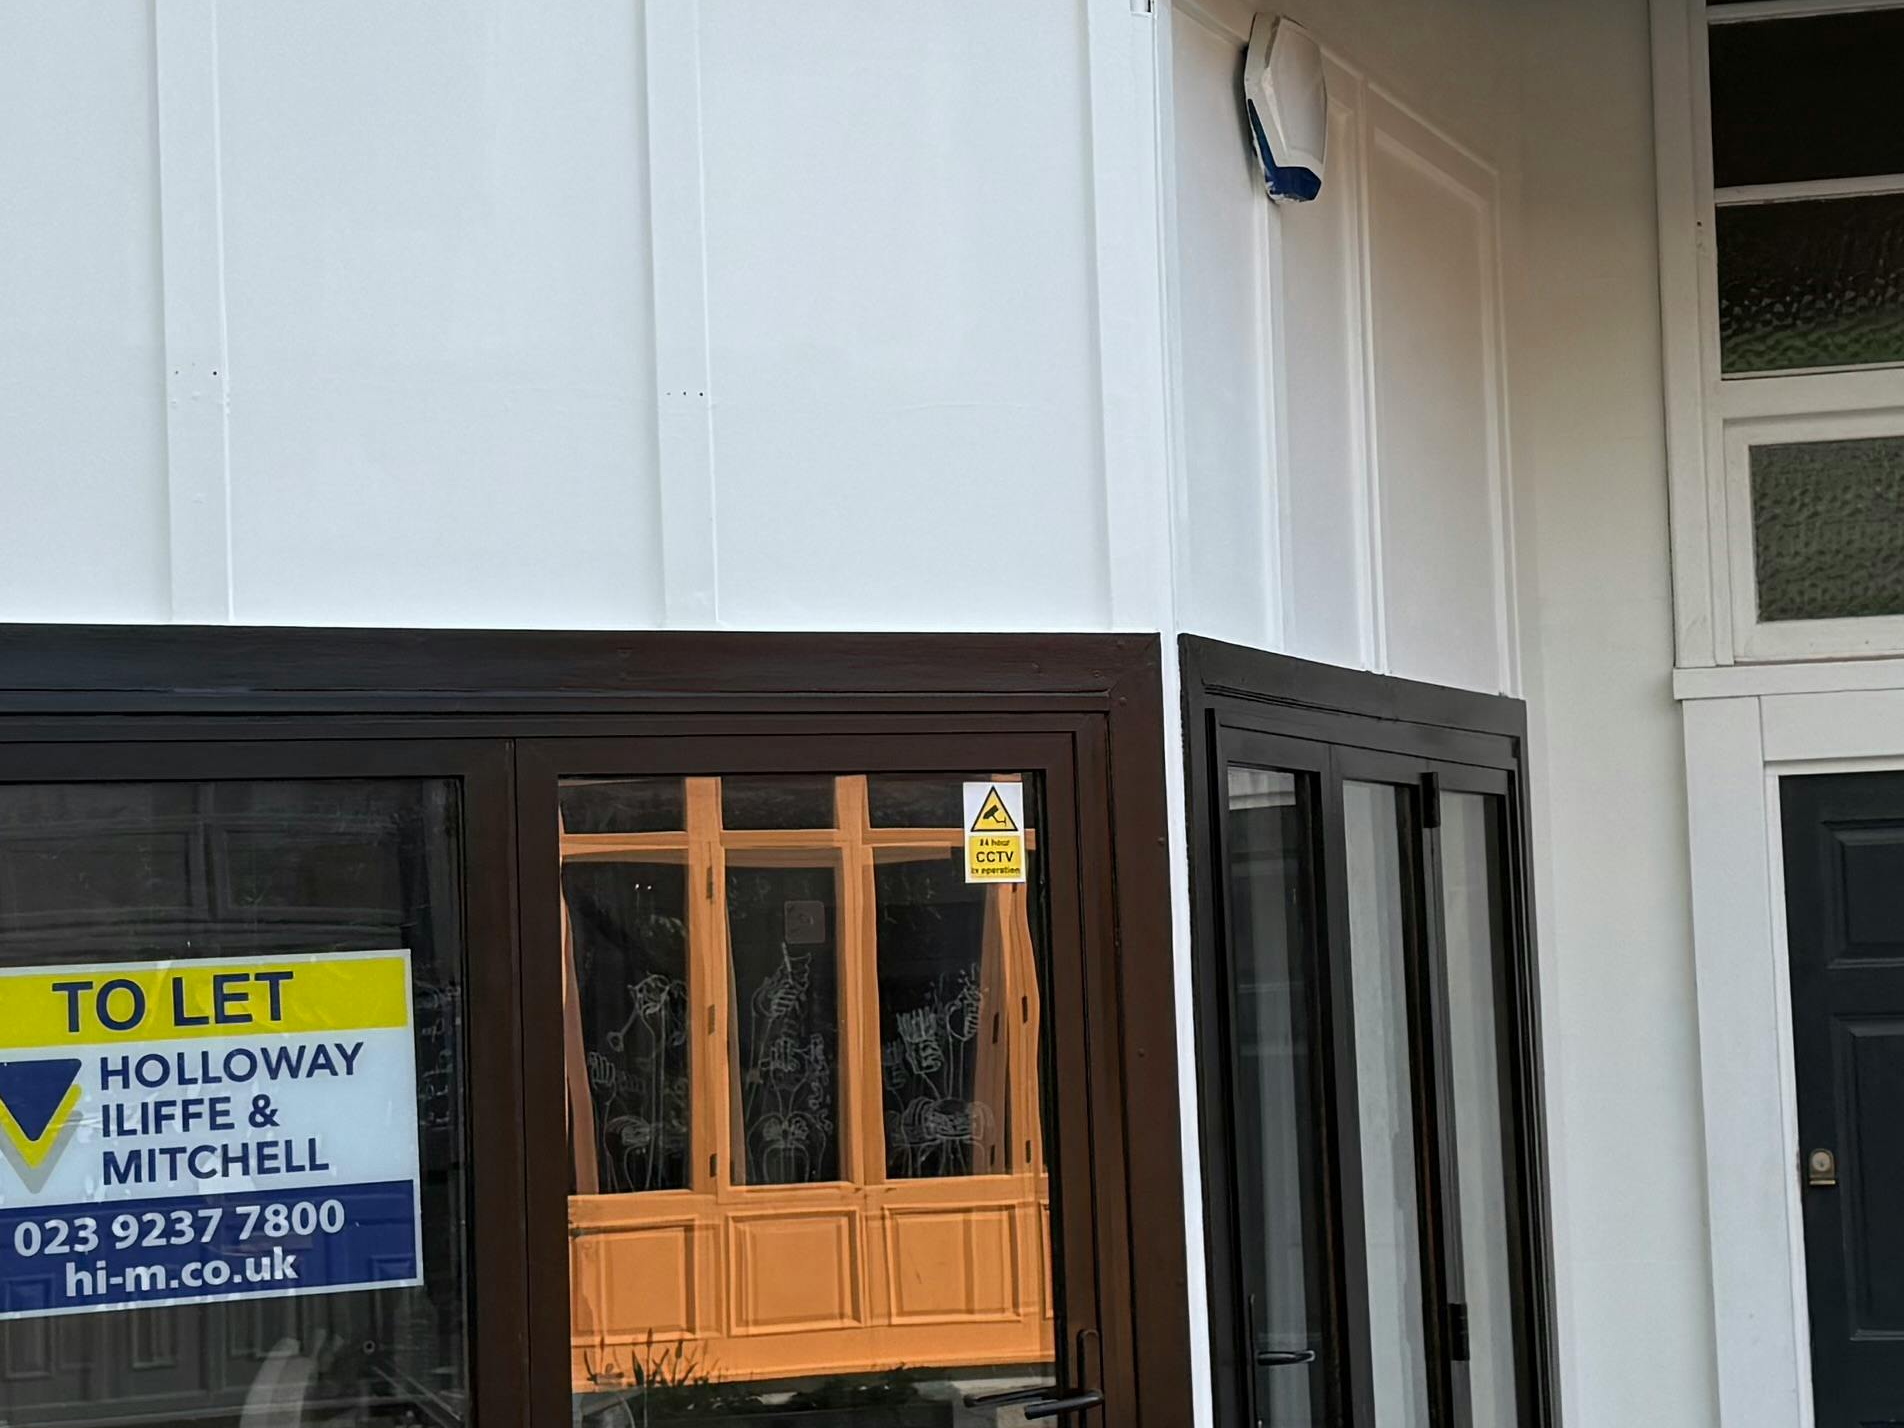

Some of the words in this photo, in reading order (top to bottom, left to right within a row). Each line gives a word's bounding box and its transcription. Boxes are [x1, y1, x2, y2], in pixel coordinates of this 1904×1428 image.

[976, 851, 1014, 863] CCTV
[981, 866, 1020, 874] operation
[51, 978, 147, 1033] TO
[171, 971, 294, 1027] LET
[99, 1041, 364, 1091] HOLLOWAY
[101, 1096, 234, 1138] ILIFFE
[247, 1093, 280, 1128] &
[102, 1137, 330, 1186] MITCHELL
[14, 1217, 99, 1258] 023
[111, 1208, 224, 1250] 9237
[235, 1199, 345, 1241] 7800
[64, 1247, 299, 1298] hi-m.co.uk
